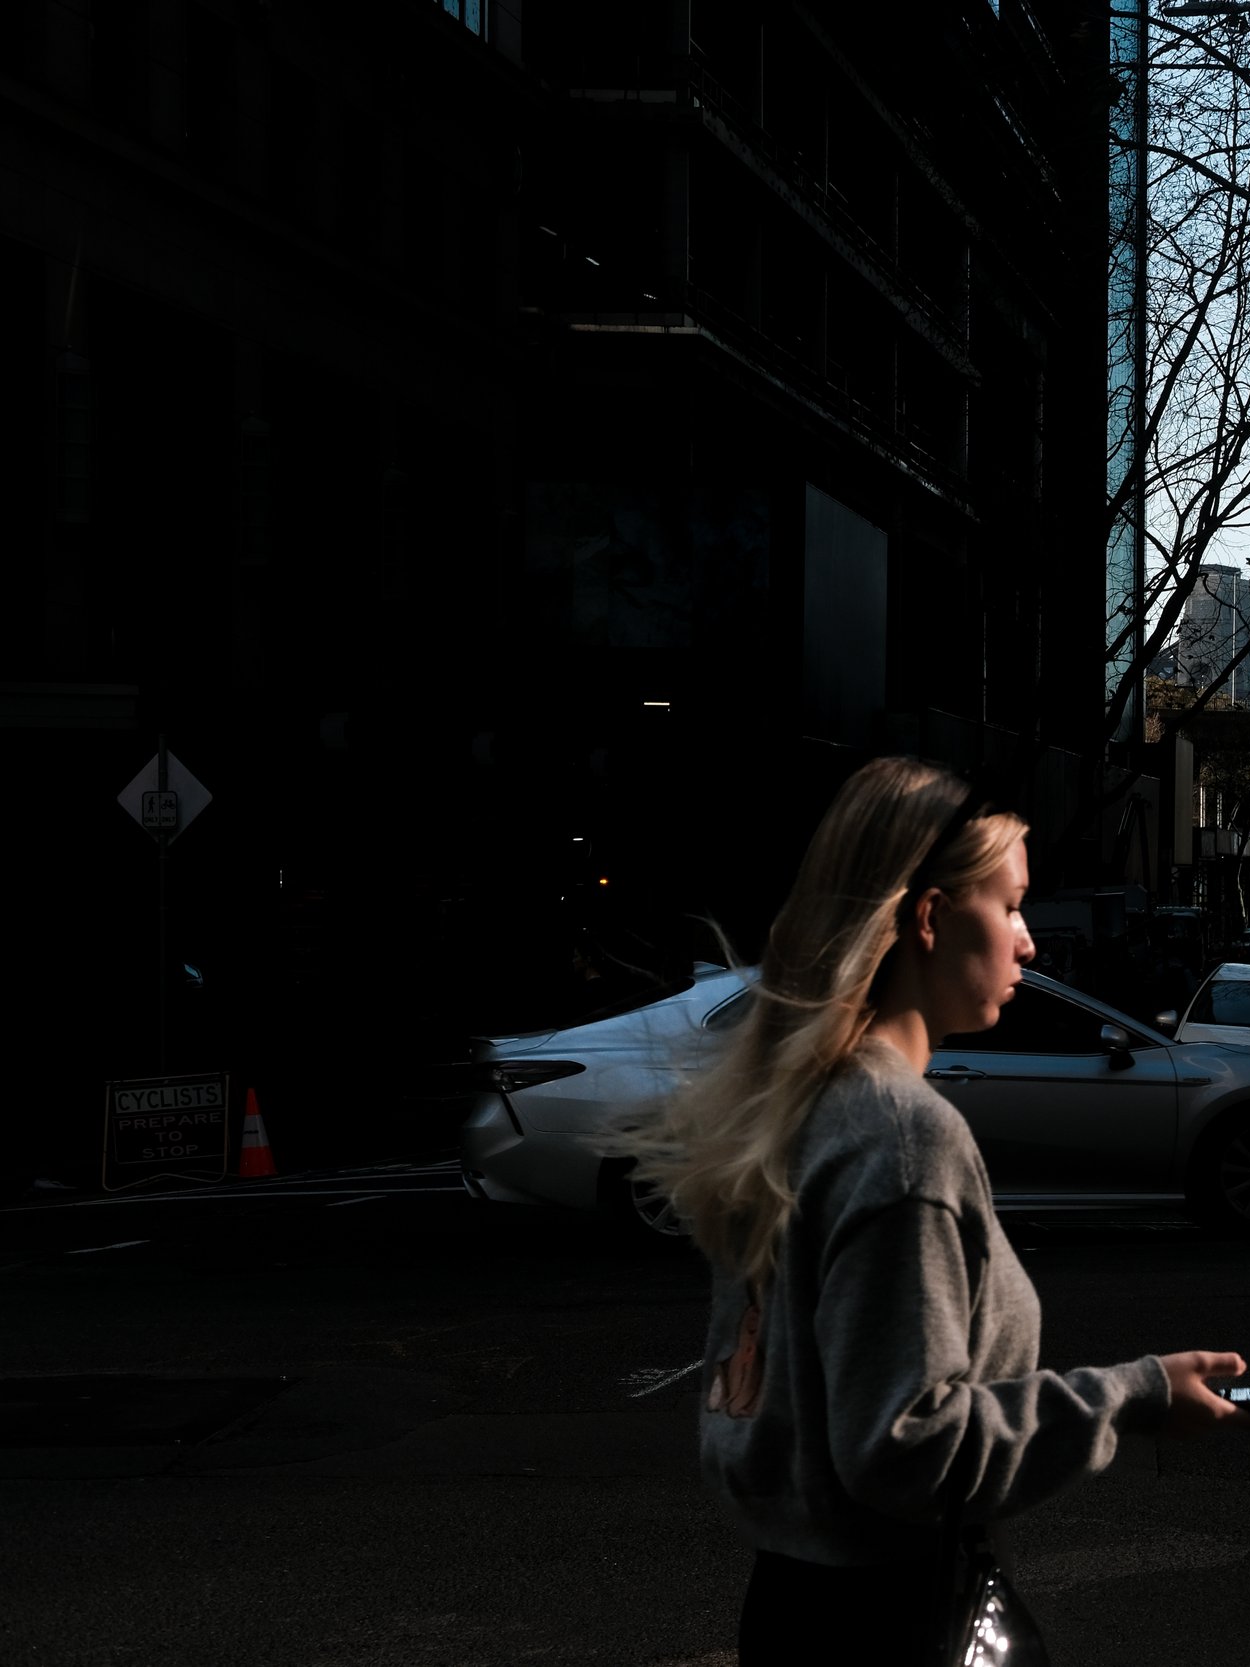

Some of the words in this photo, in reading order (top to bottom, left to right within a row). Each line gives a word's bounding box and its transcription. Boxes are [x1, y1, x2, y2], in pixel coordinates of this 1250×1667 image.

[118, 1086, 219, 1110] CYCLISTS
[119, 1112, 223, 1130] PREPARE
[155, 1130, 183, 1144] TO
[142, 1144, 199, 1159] STOP
